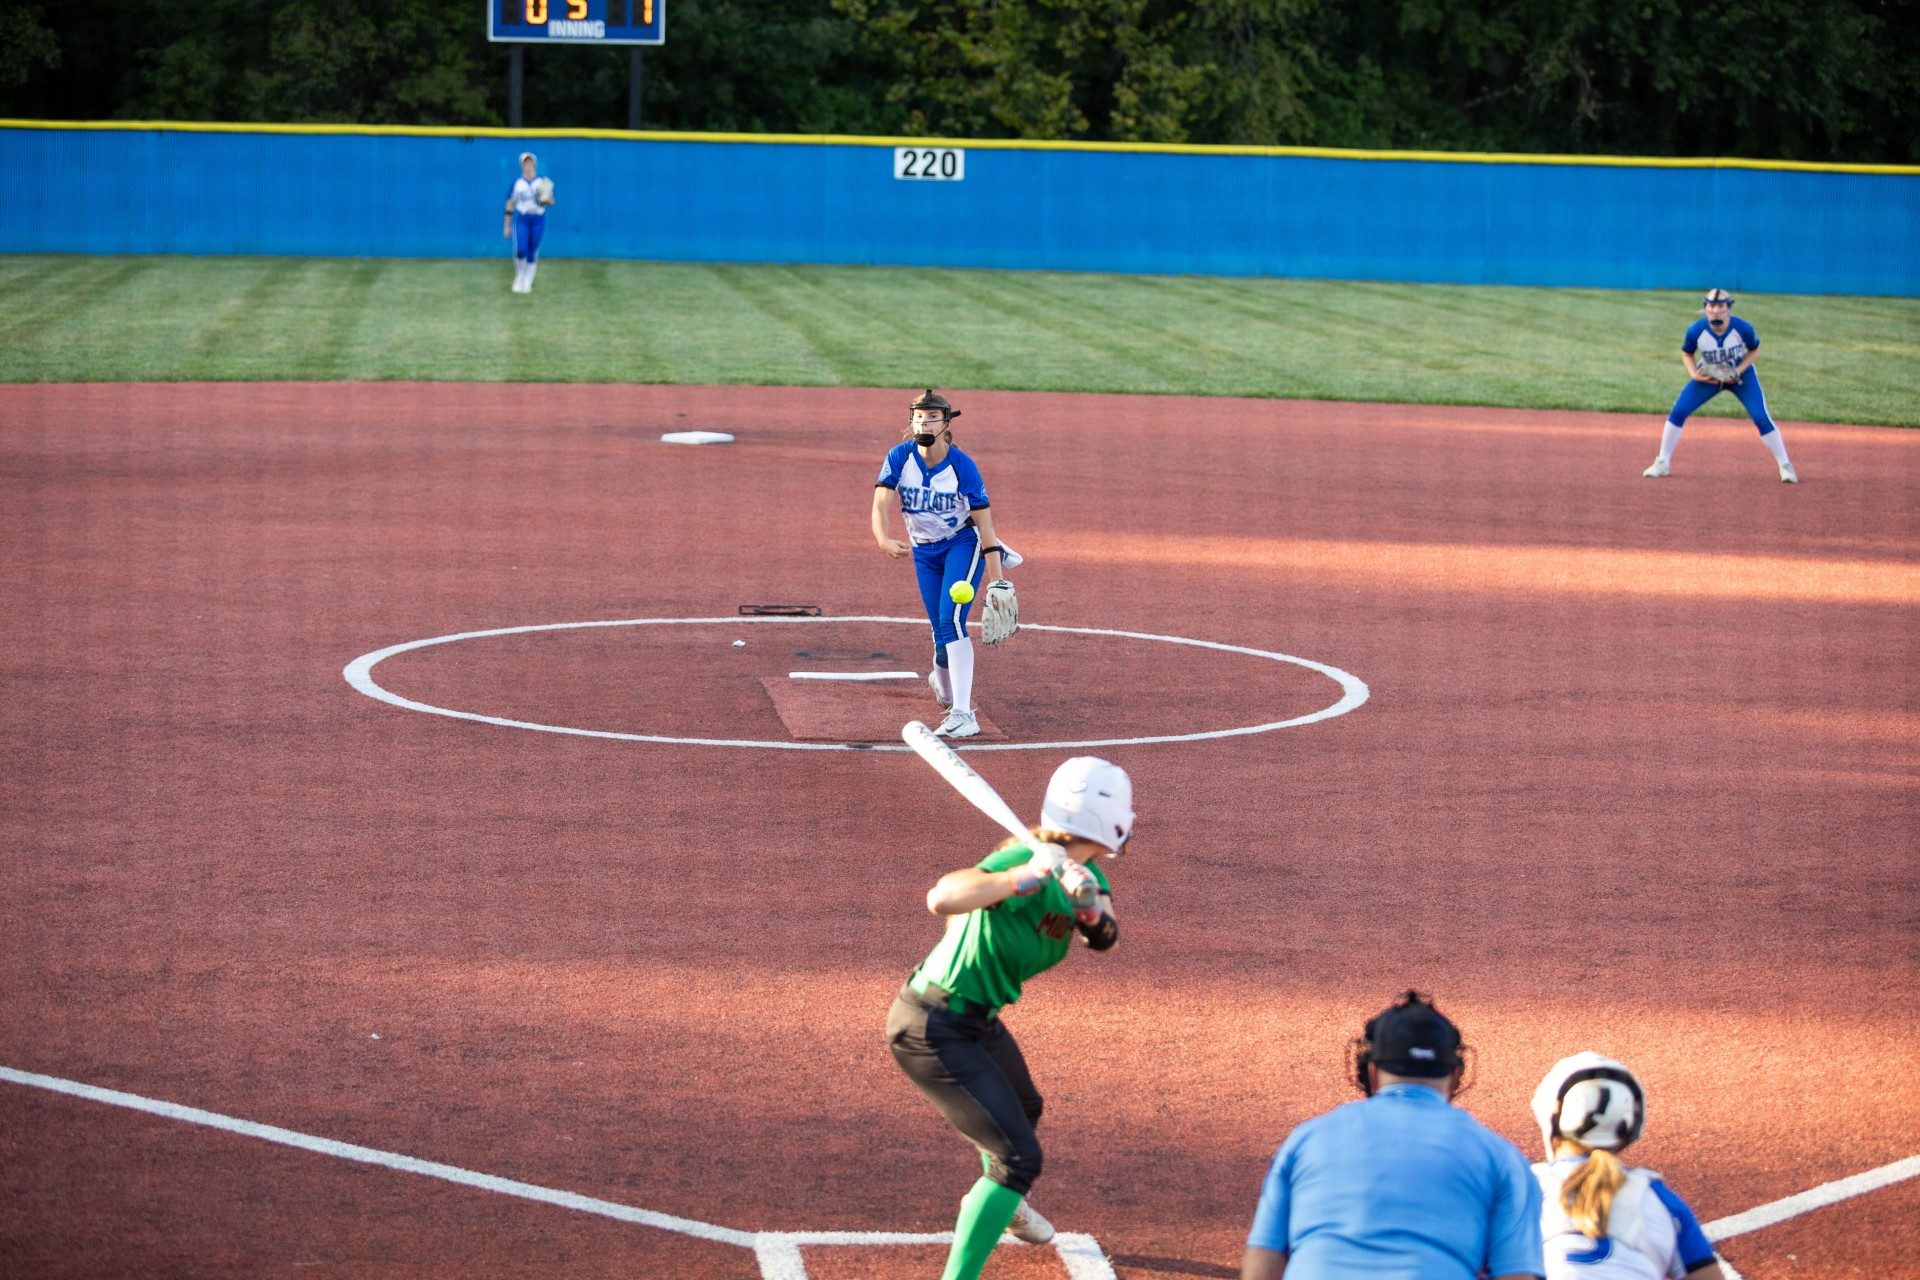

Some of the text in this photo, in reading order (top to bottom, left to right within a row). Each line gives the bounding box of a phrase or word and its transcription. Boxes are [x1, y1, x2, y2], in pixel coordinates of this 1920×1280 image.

[549, 20, 605, 38] INNING
[903, 151, 956, 177] 220
[899, 486, 920, 508] EST
